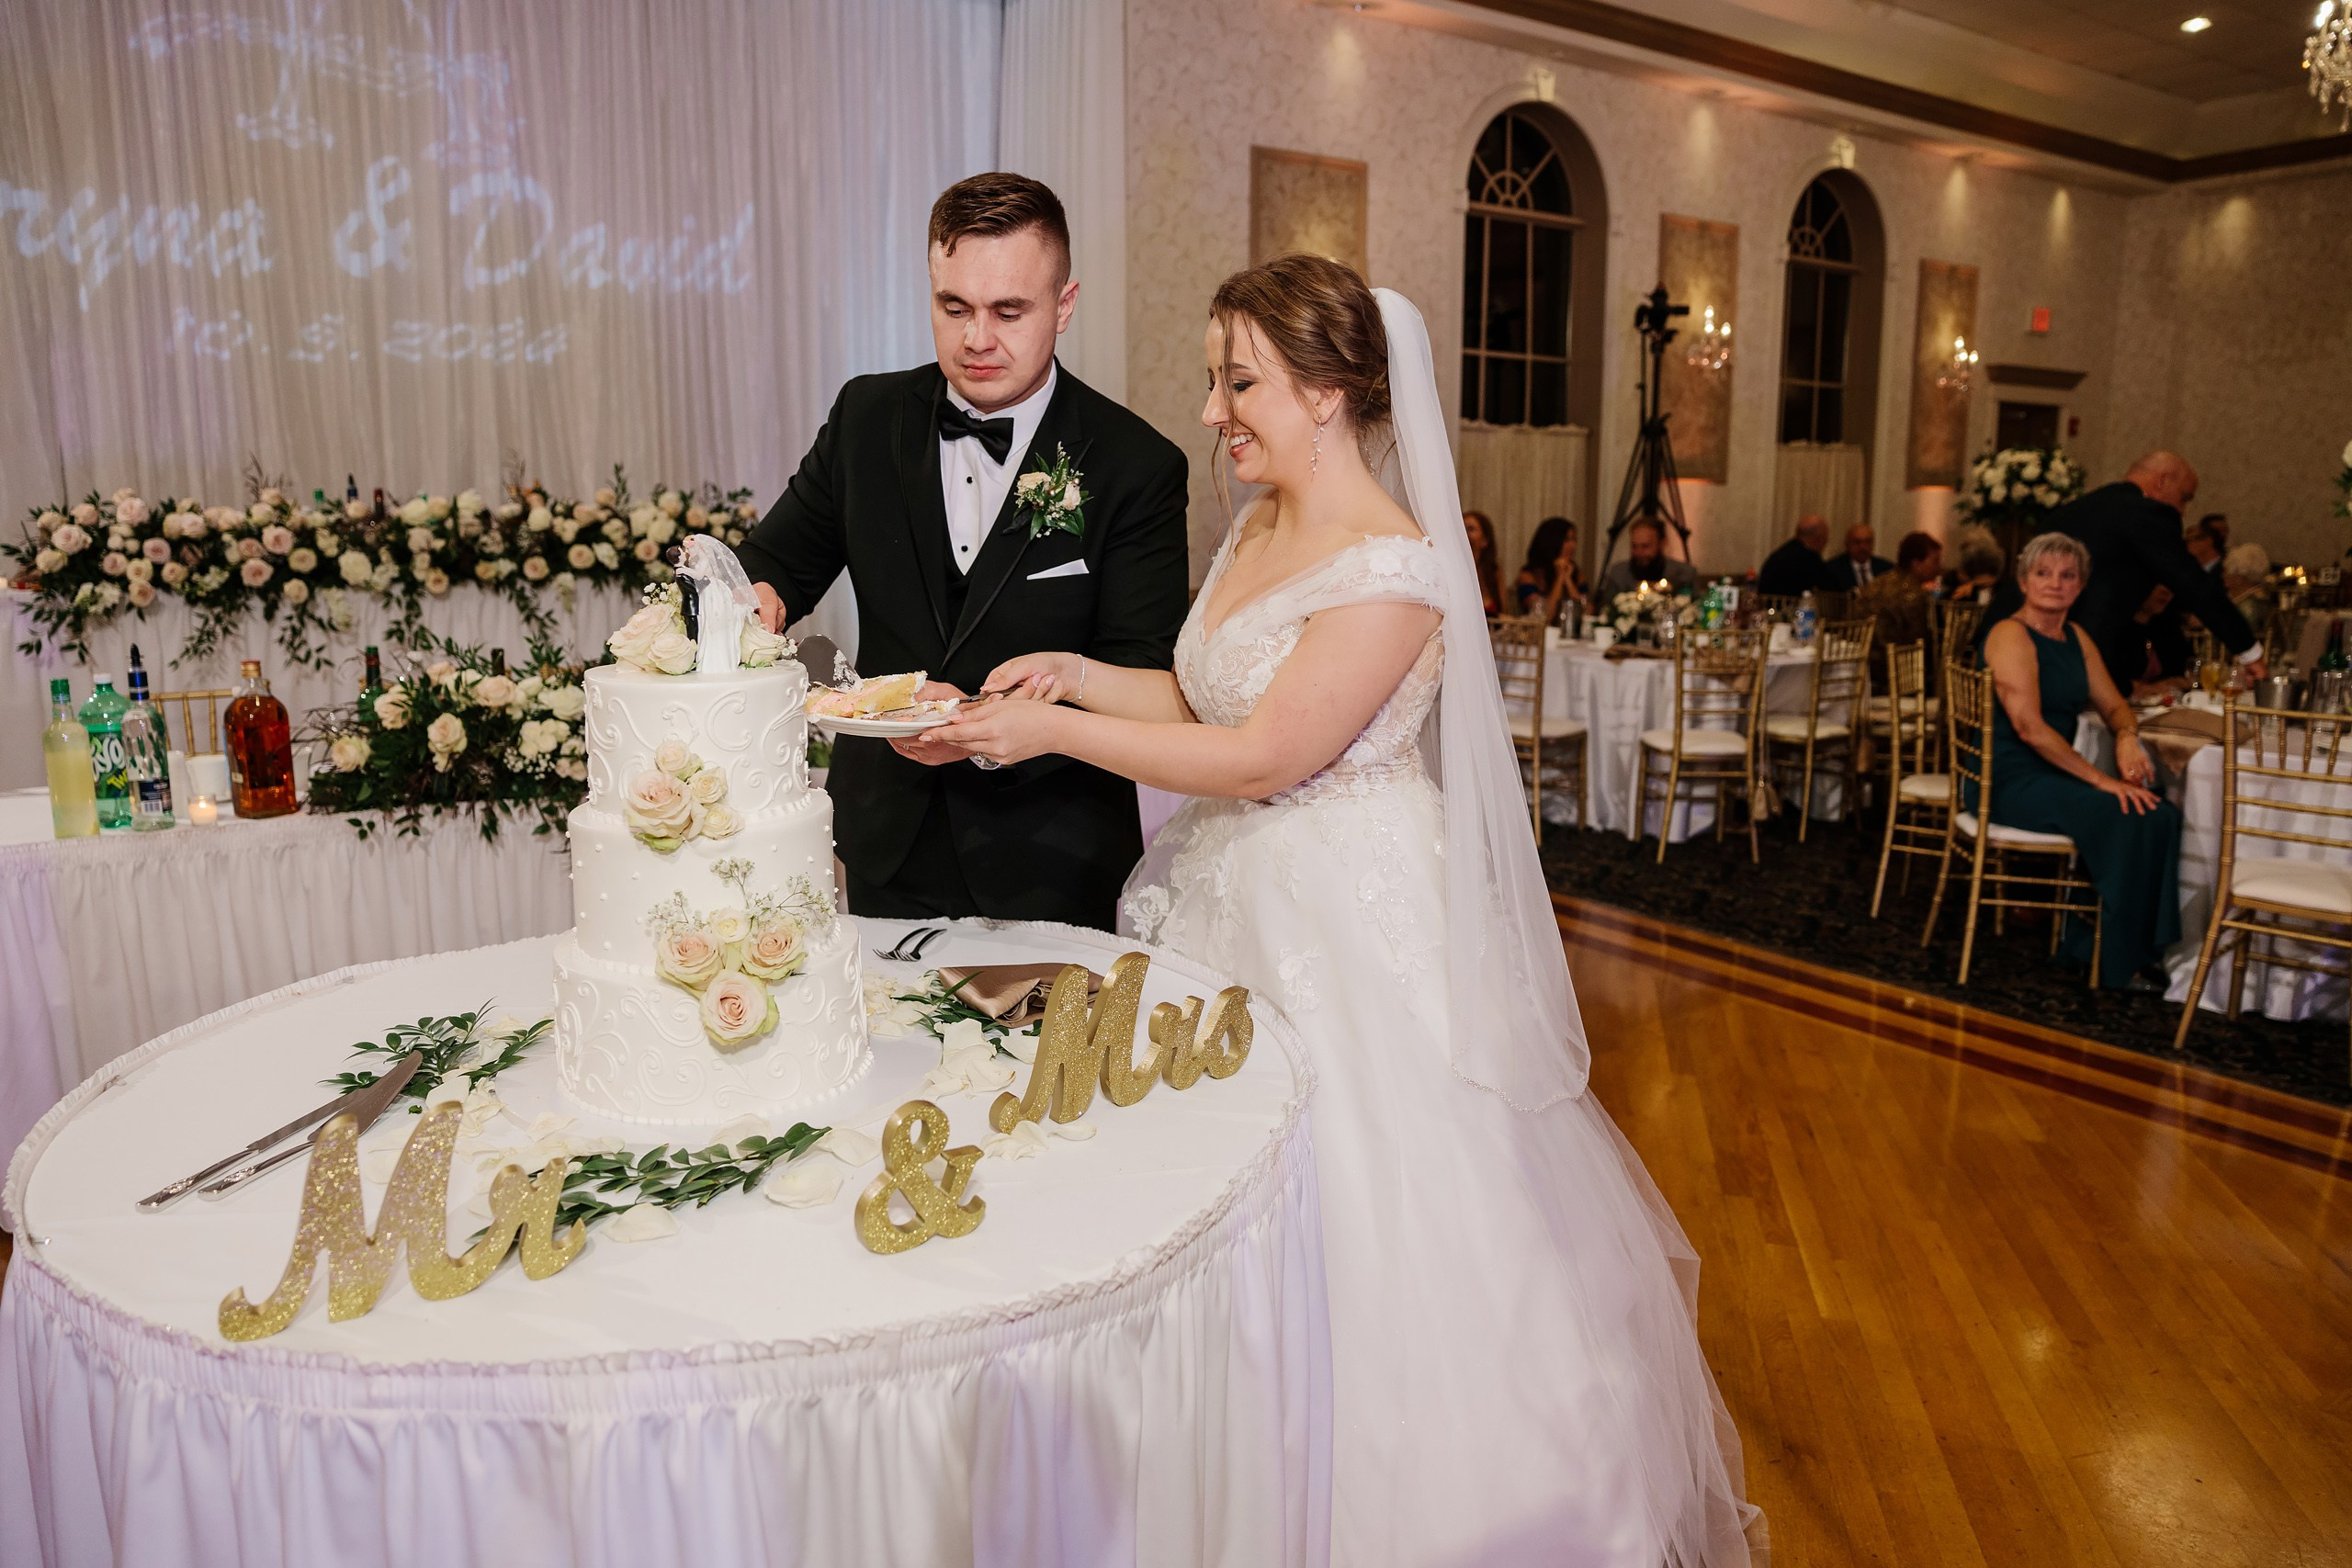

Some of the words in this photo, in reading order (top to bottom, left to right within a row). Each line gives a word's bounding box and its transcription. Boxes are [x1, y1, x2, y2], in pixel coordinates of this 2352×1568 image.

[334, 155, 412, 278] &
[449, 168, 755, 294] David
[219, 1100, 587, 1342] Mr
[854, 1100, 987, 1255] &
[989, 951, 1255, 1135] Mrs
